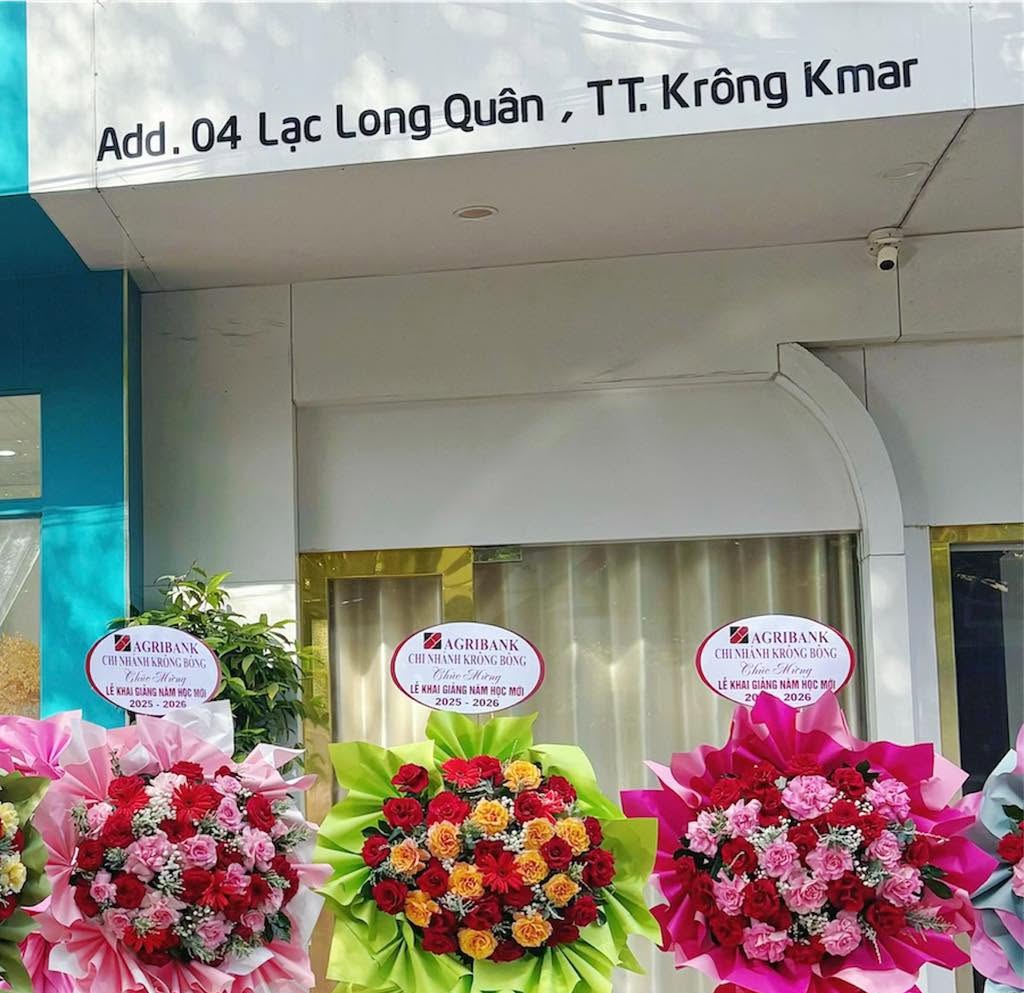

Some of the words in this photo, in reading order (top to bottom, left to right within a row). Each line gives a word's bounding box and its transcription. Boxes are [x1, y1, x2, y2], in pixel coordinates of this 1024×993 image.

[97, 120, 180, 162] Add.
[191, 115, 242, 152] 04
[258, 111, 322, 153] Lạc
[336, 103, 432, 141] Long
[443, 87, 545, 132] Quân
[586, 76, 648, 116] TT.
[662, 67, 788, 109] Krông
[803, 58, 919, 97] Kmar
[751, 632, 828, 643] AGRIBANK
[133, 641, 199, 654] AGRIBANK
[444, 638, 520, 651] AGRIBANK
[408, 653, 425, 664] CHI
[427, 651, 461, 665] NHÁNH
[463, 651, 497, 665] KRÔNG
[715, 648, 732, 659] CHI
[734, 646, 769, 659] NHÁNH
[772, 645, 808, 659] KRÔNG
[102, 655, 118, 666] CHI
[119, 653, 150, 667] NHÁNH
[152, 654, 182, 668] KRÔNG
[432, 667, 461, 680] Chúc
[741, 662, 770, 675] Chúc
[126, 670, 150, 683] Chúc
[116, 687, 133, 696] KHAI
[178, 689, 192, 699] HỌC
[422, 684, 440, 694] KHAI
[491, 685, 506, 698] HỌC
[730, 680, 750, 690] KHAI
[801, 680, 818, 693] HỌC
[435, 698, 462, 706] 2025
[473, 698, 499, 707] 2026
[784, 693, 811, 701] 2026
[130, 700, 153, 708] 2025
[162, 700, 187, 708] 2026
